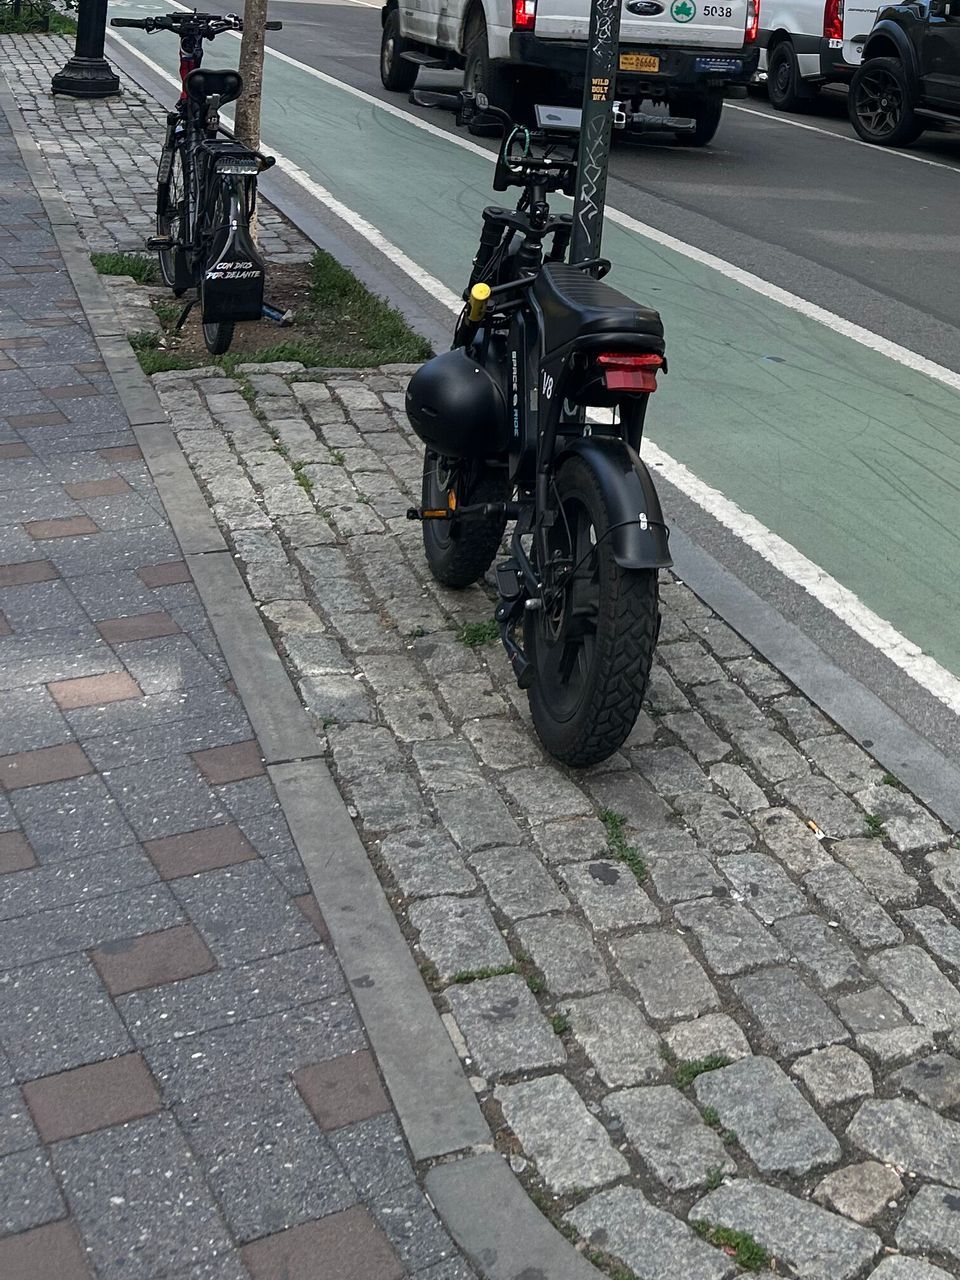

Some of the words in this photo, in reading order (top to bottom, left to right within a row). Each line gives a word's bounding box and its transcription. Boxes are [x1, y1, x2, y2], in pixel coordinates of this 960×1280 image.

[703, 5, 732, 18] 5038
[216, 262, 233, 270] CON
[206, 272, 224, 280] POR
[225, 270, 261, 279] DELANTE
